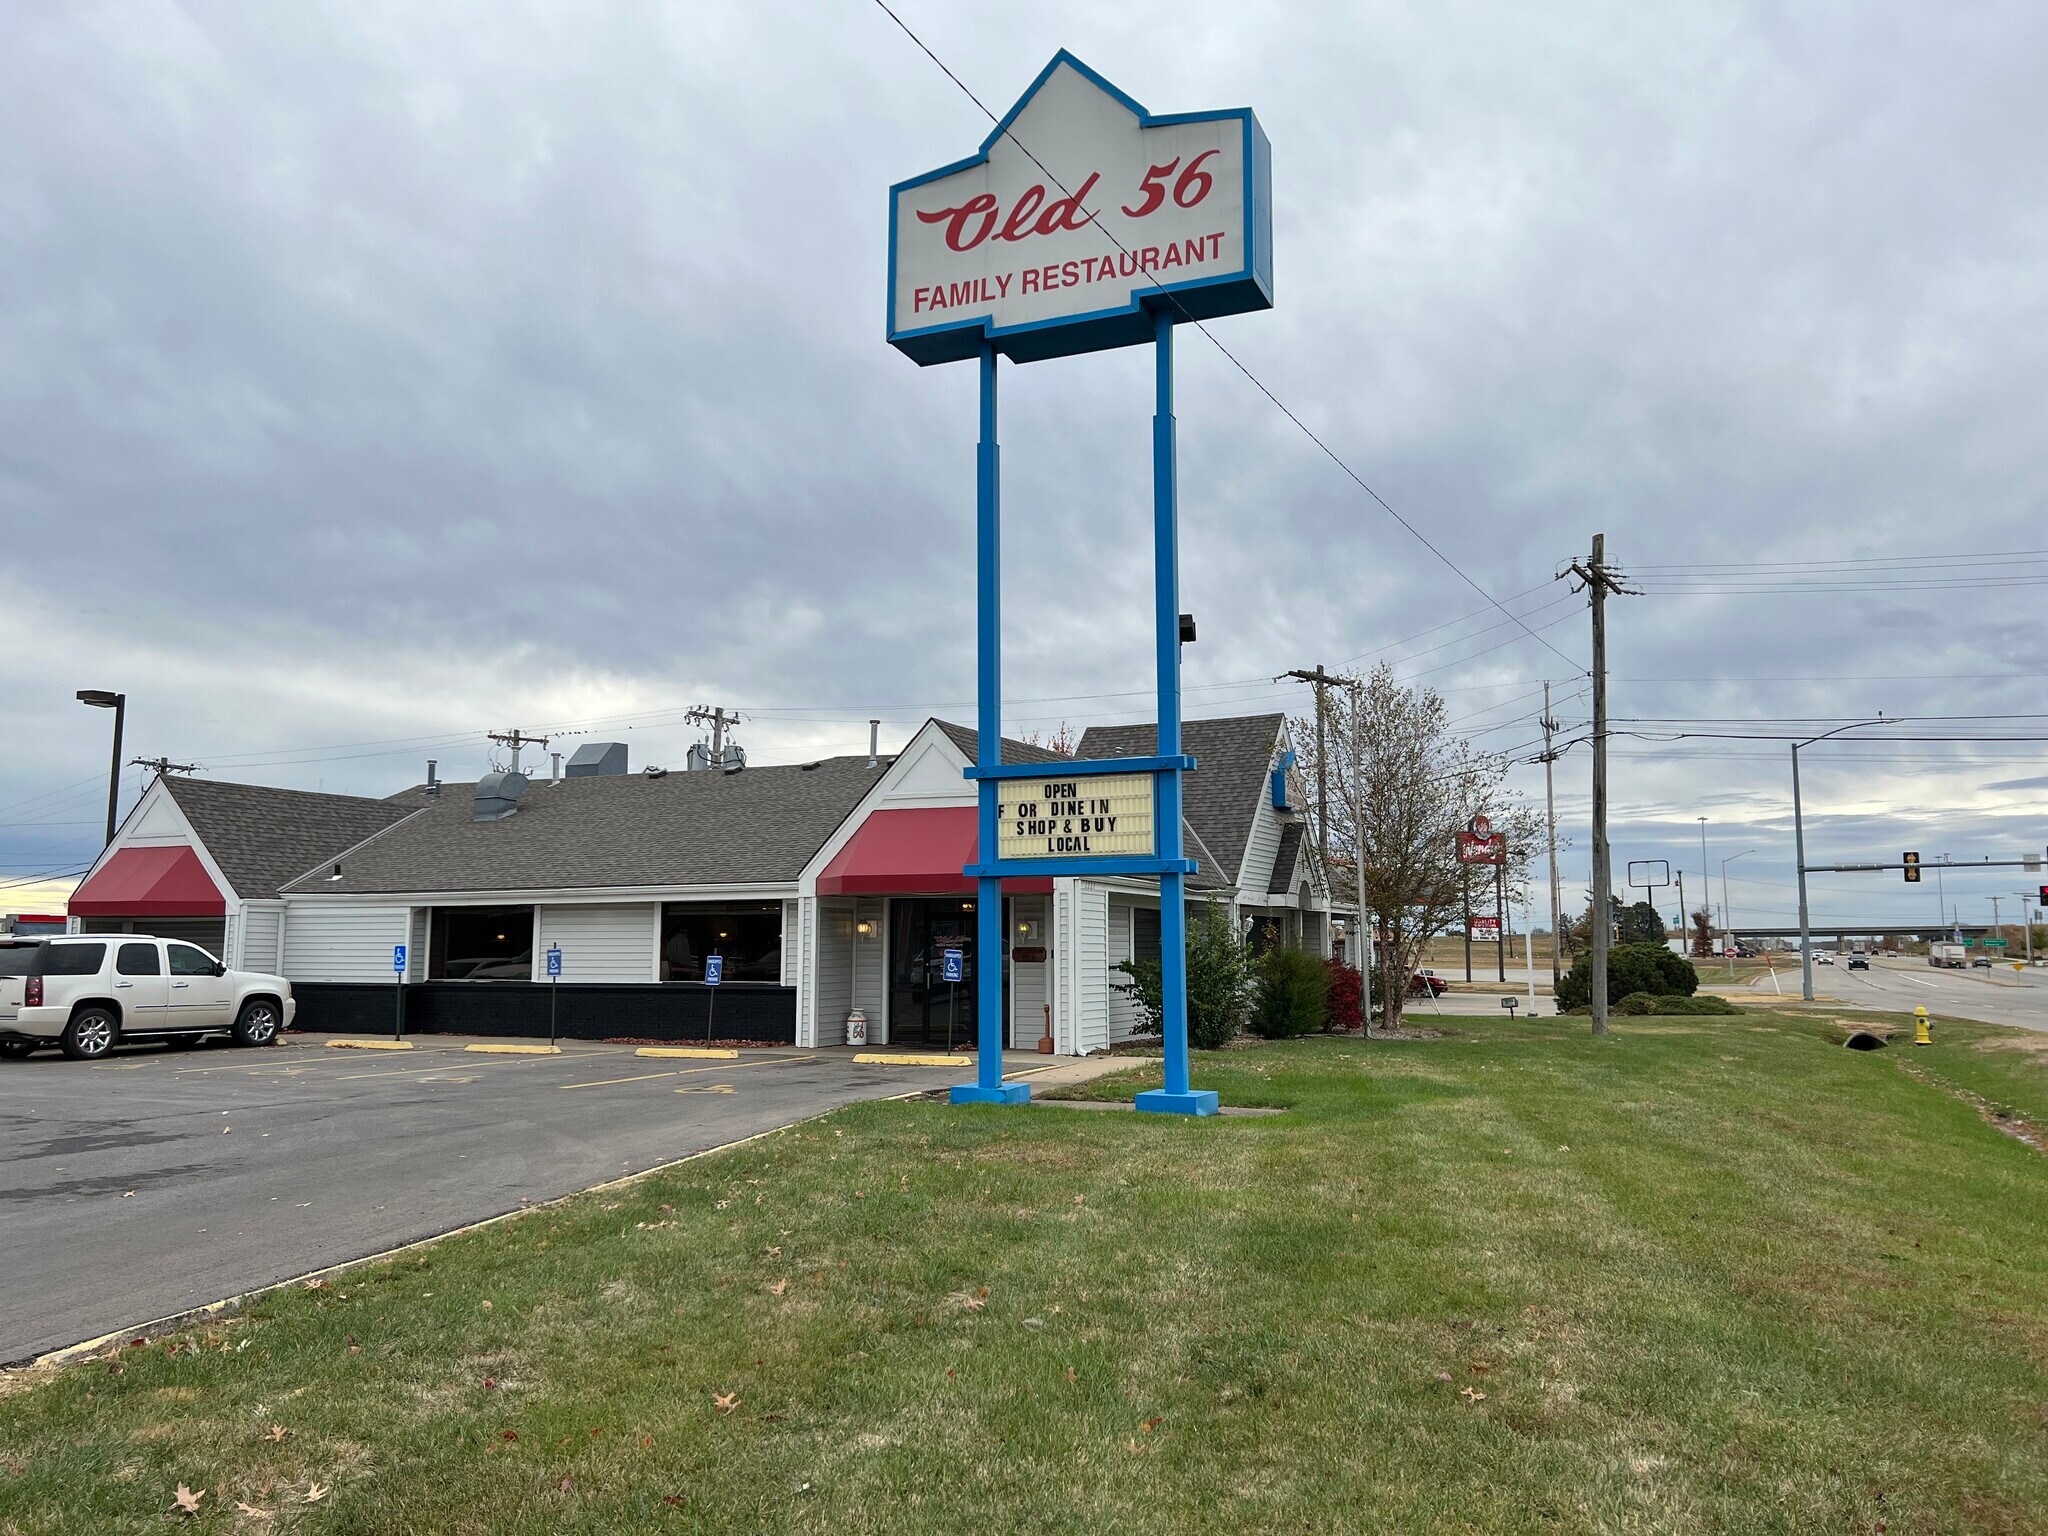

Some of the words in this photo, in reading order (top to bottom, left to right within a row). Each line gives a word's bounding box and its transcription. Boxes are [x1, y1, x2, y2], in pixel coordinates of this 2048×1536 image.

[916, 171, 1101, 252] Old
[1121, 149, 1221, 218] 56
[914, 273, 1013, 313] FAMILY
[1021, 231, 1226, 295] RESTAURANT
[1044, 783, 1077, 799] OPEN
[1051, 800, 1085, 816] DINE
[1090, 799, 1109, 814] IN
[1016, 819, 1056, 836] SHOP
[1063, 819, 1072, 833] &
[1081, 817, 1117, 833] BUY
[1048, 836, 1091, 853] LOCAL
